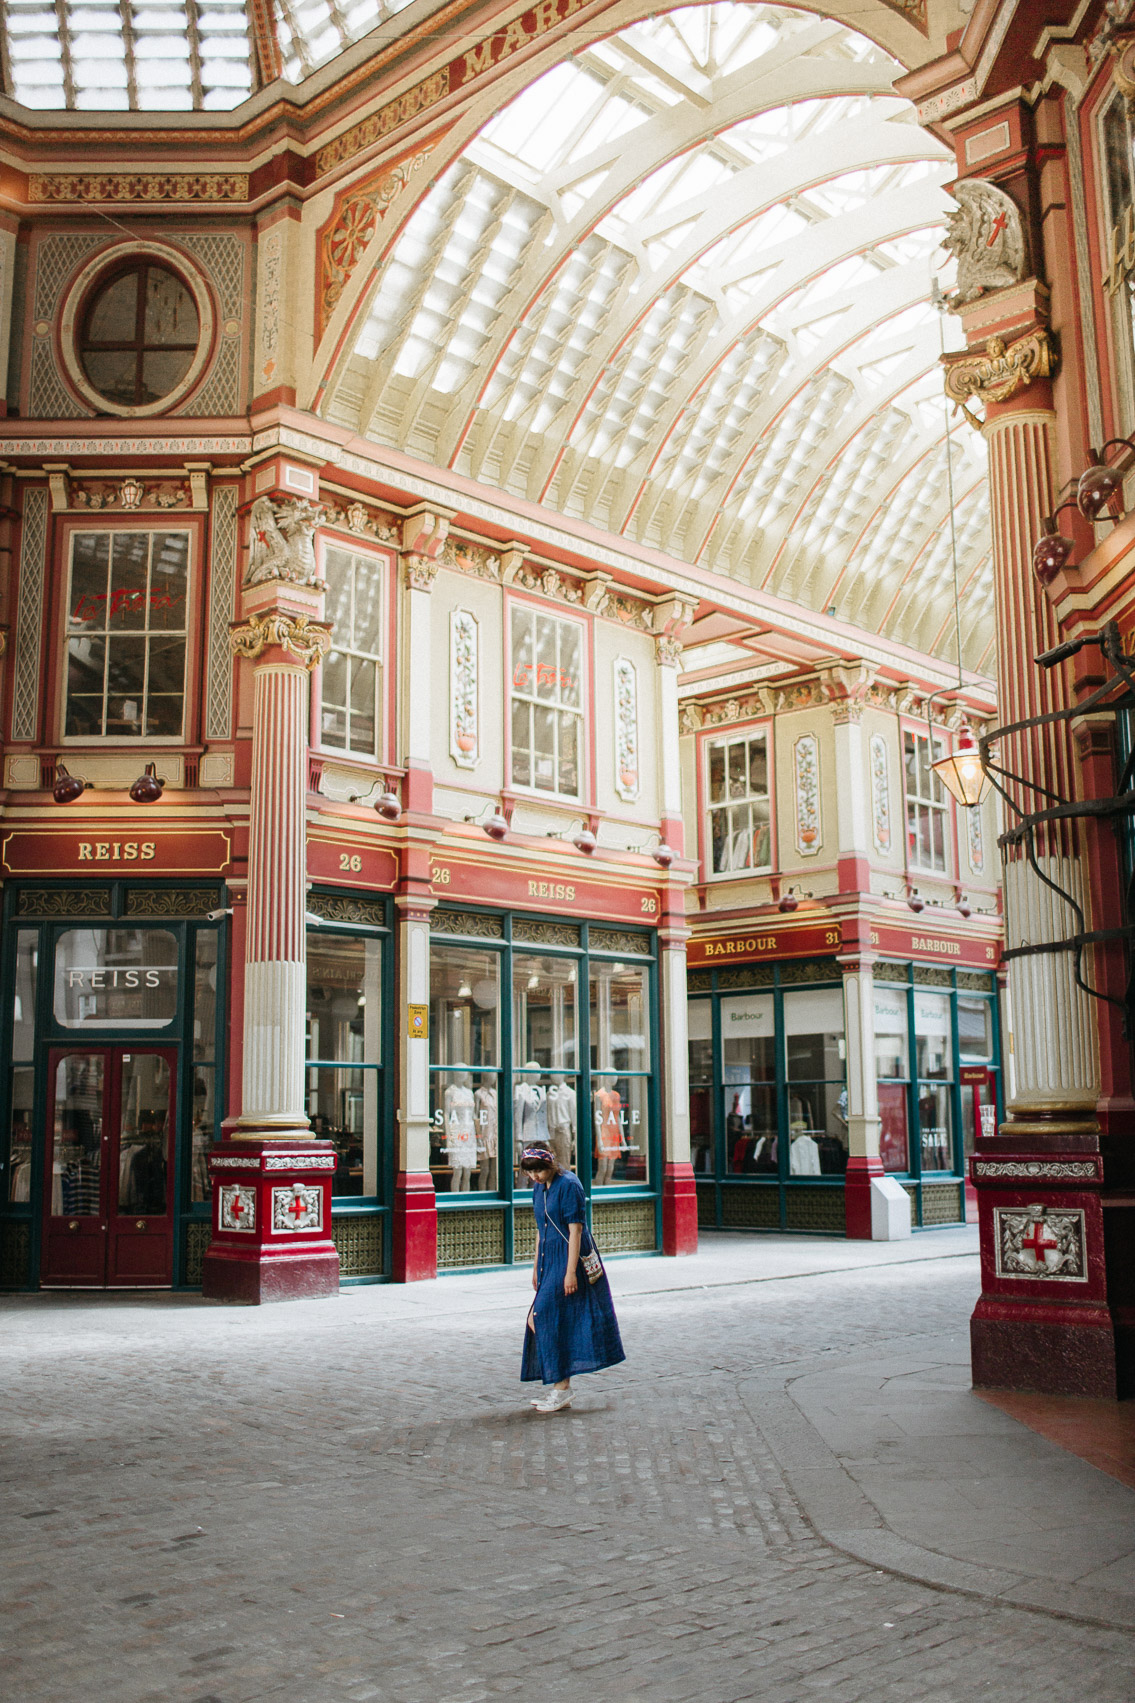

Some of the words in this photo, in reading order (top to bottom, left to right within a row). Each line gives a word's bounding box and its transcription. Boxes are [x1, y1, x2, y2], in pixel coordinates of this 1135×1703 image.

[77, 842, 157, 861] REISS
[339, 852, 363, 873] 26
[431, 867, 451, 884] 26
[527, 879, 576, 901] REISS
[640, 897, 656, 913] 26
[704, 937, 778, 956] BARBOUR
[825, 931, 840, 945] 31
[871, 931, 880, 945] 31
[911, 936, 961, 955] BARBOUR
[985, 947, 995, 960] 31
[68, 970, 161, 988] REISS
[731, 1012, 764, 1021] Barbour
[434, 1108, 489, 1126] SALE
[595, 1110, 641, 1125] SALE
[921, 1133, 948, 1148] SALE
